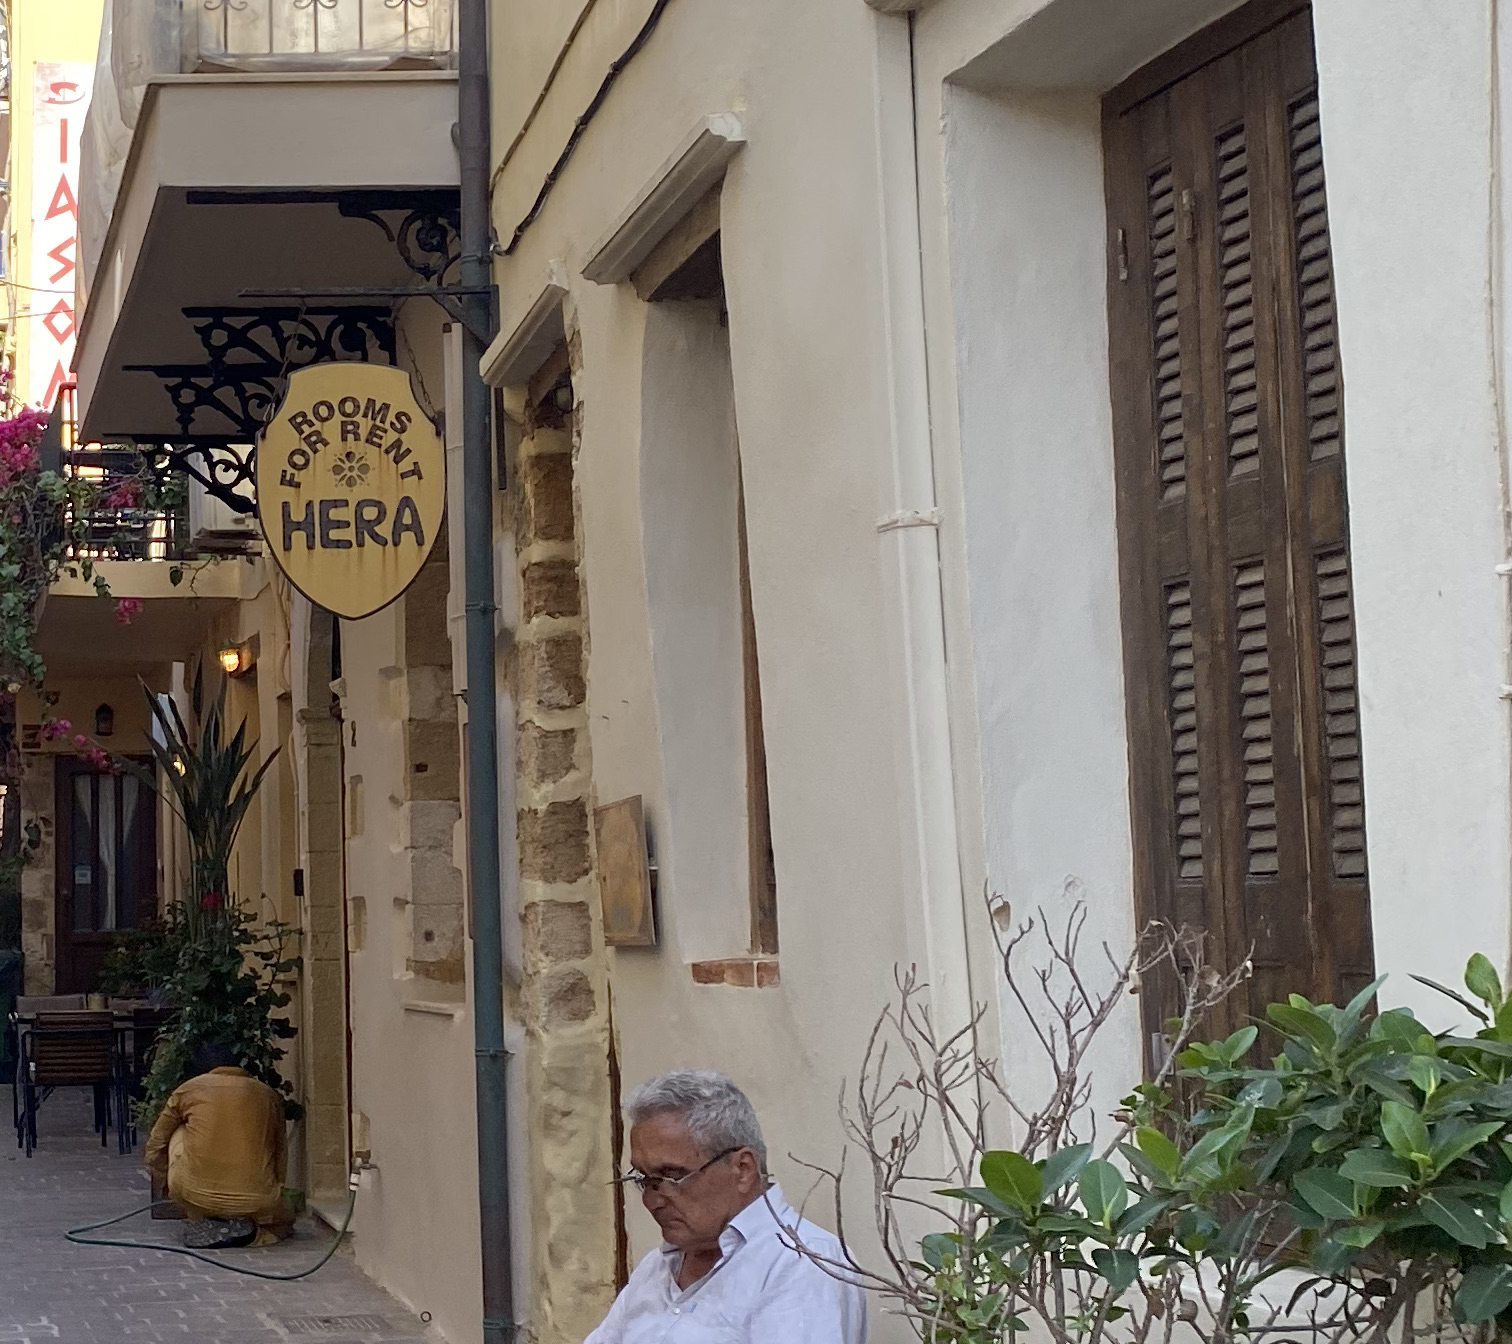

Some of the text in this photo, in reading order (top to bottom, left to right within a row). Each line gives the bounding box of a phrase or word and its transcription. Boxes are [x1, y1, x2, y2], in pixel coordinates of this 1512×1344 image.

[287, 395, 412, 436] ROOMS
[279, 420, 424, 489] FOR RENT
[281, 495, 425, 552] HERA
